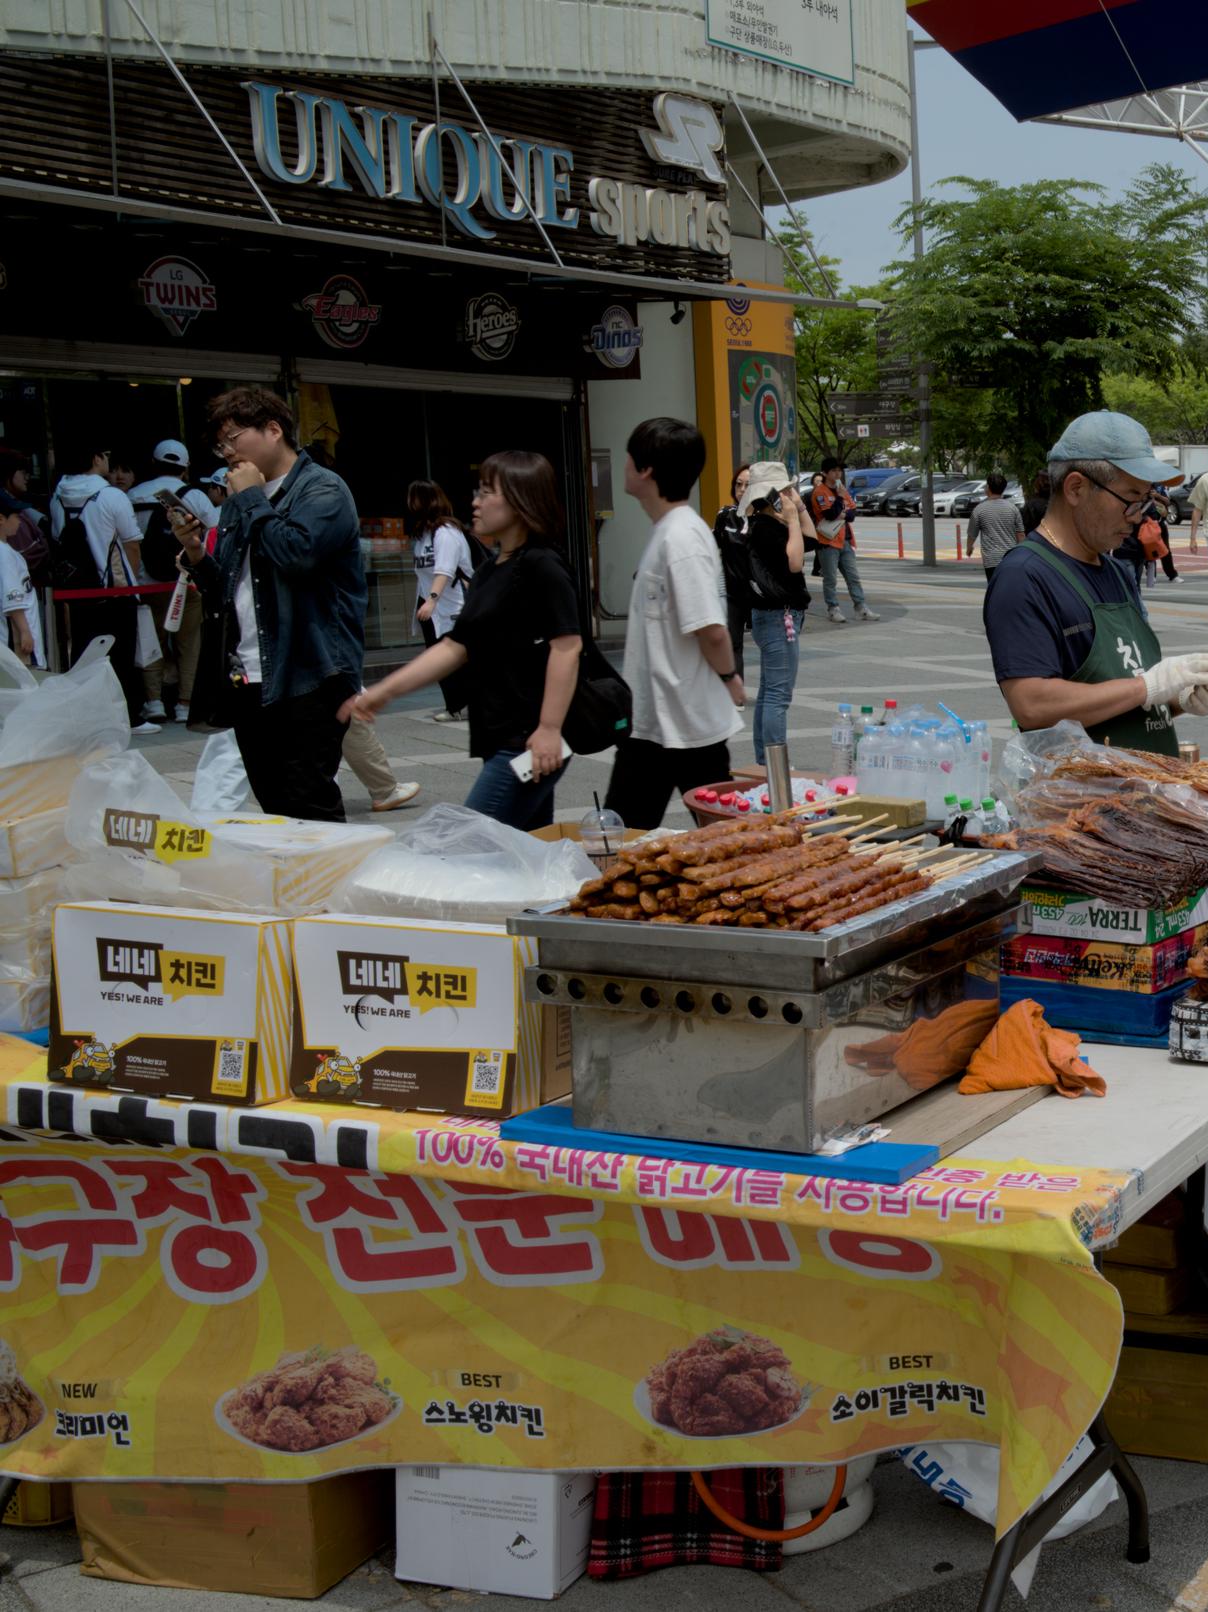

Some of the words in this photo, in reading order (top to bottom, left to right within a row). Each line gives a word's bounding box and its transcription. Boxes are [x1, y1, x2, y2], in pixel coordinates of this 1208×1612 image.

[242, 81, 580, 239] UNIQUE
[589, 178, 730, 255] sports
[169, 269, 183, 281] LG
[139, 280, 216, 309] TWINS
[306, 293, 381, 324] Eagles
[107, 815, 154, 843] 네네
[161, 827, 206, 853] 치킨
[1089, 906, 1142, 932] TERRA
[106, 945, 156, 976] 네네
[169, 958, 217, 989] 치킨
[349, 958, 400, 990] 네네
[416, 970, 468, 1001] 치킨
[100, 991, 125, 1002] YES!
[126, 994, 142, 1004] WE
[142, 995, 164, 1006] ARE
[371, 1006, 387, 1017] WE
[389, 1007, 411, 1019] ARE
[373, 1068, 390, 1078] 100%
[416, 1129, 504, 1169] 100%
[516, 1145, 625, 1191] 국내산
[637, 1158, 785, 1205] 닭고기를
[798, 1174, 1002, 1221] 사용합니다.
[998, 1172, 1078, 1192] 받은
[0, 1157, 258, 1293] 구장
[888, 1354, 934, 1371] BEST
[61, 1382, 98, 1399] NEW
[460, 1372, 502, 1388] BEST
[831, 1380, 987, 1421] 소이갈릭치킨
[423, 1400, 545, 1437] 스노윙치킨
